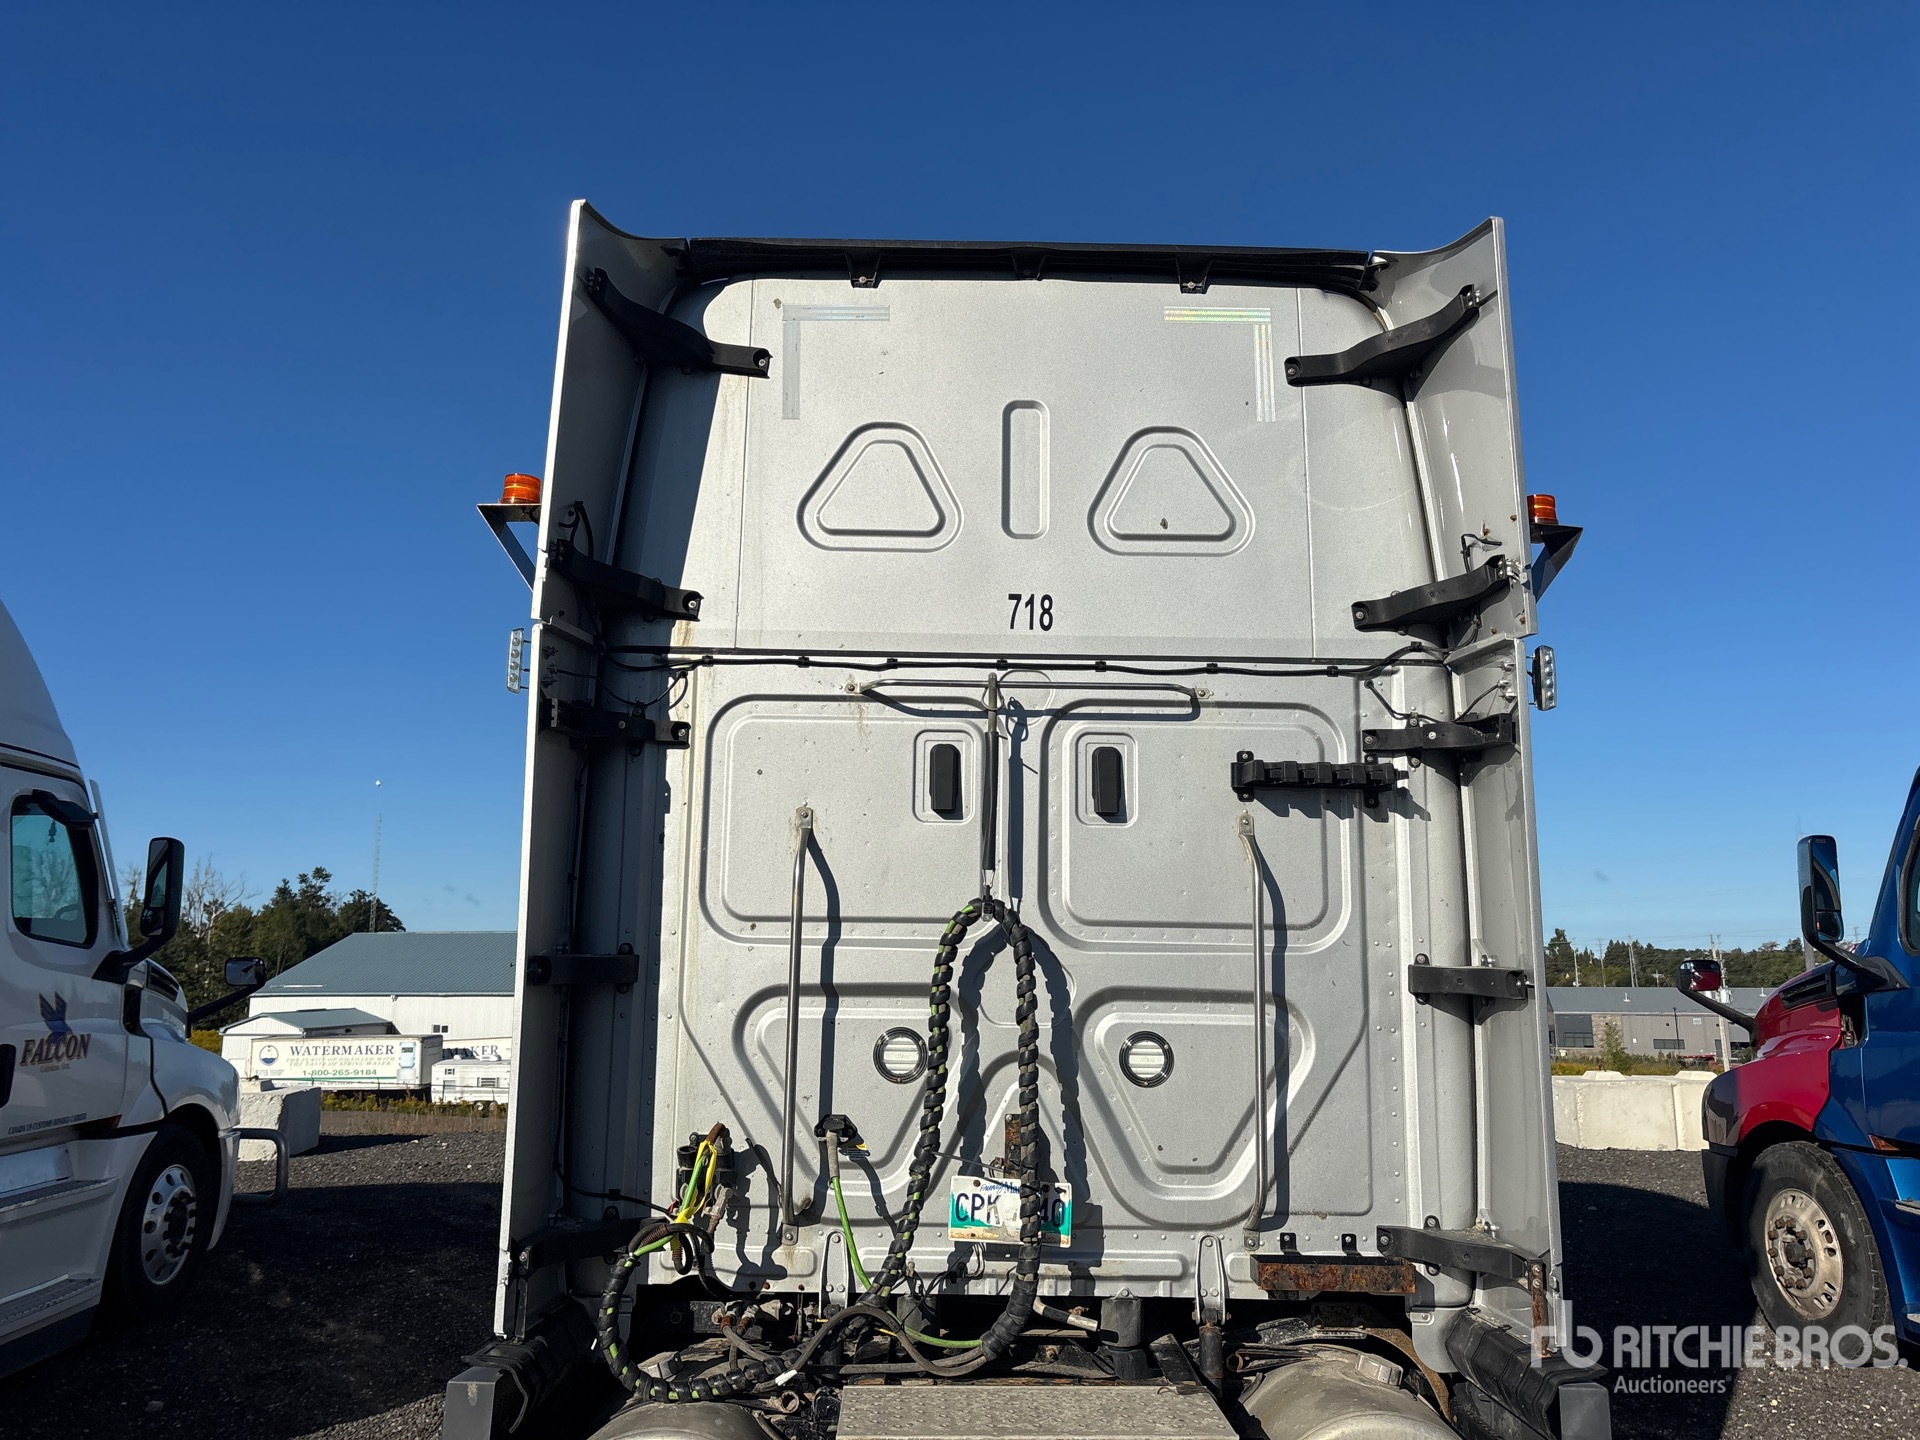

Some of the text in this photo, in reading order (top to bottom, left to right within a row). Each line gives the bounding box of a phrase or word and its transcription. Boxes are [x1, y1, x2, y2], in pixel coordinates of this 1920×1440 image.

[1008, 593, 1054, 632] 718
[19, 1033, 92, 1066] FALCON
[290, 1044, 394, 1056] WATERMAKER
[442, 1045, 499, 1059] MAKER
[302, 1069, 377, 1077] 1-800-265-9184
